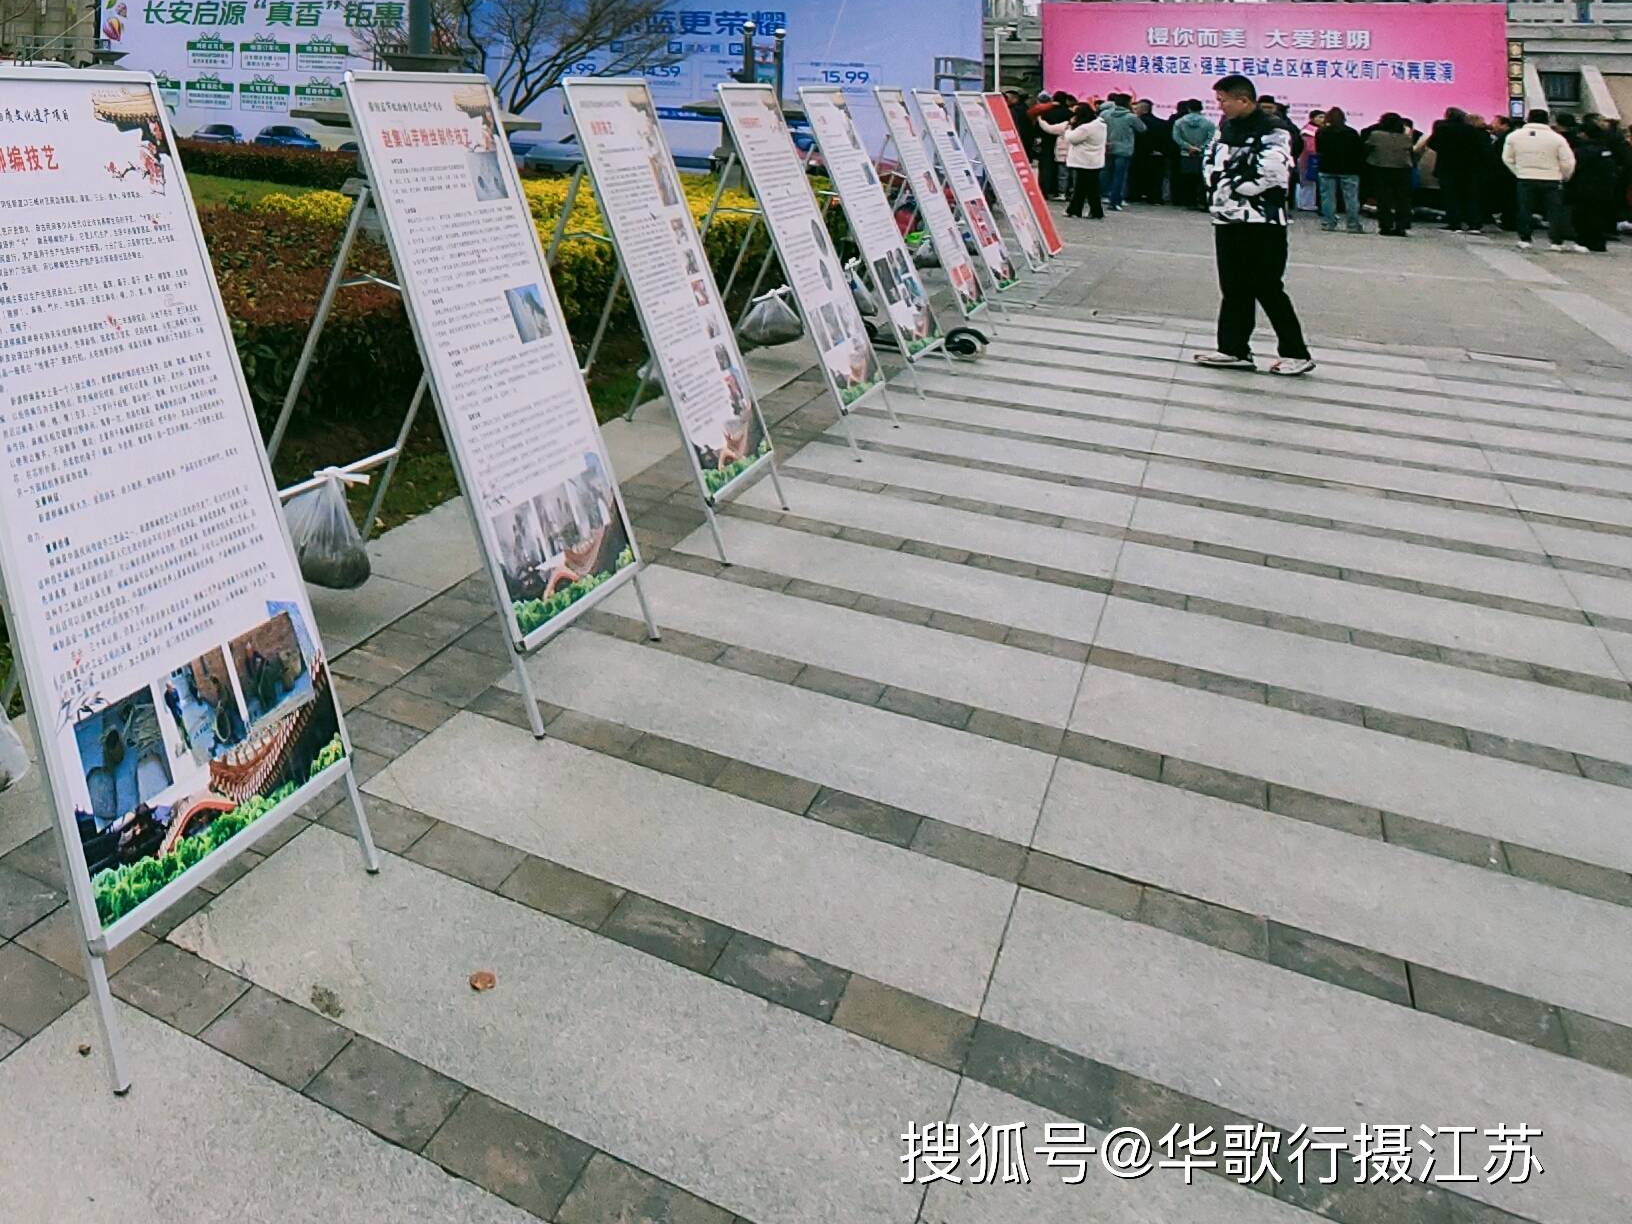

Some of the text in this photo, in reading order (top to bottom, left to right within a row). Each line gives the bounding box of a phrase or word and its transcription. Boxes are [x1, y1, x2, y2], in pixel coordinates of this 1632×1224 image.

[622, 11, 786, 36] 蓝更荣耀
[1266, 29, 1370, 49] 大爱淮阴
[821, 70, 869, 84] 15.99
